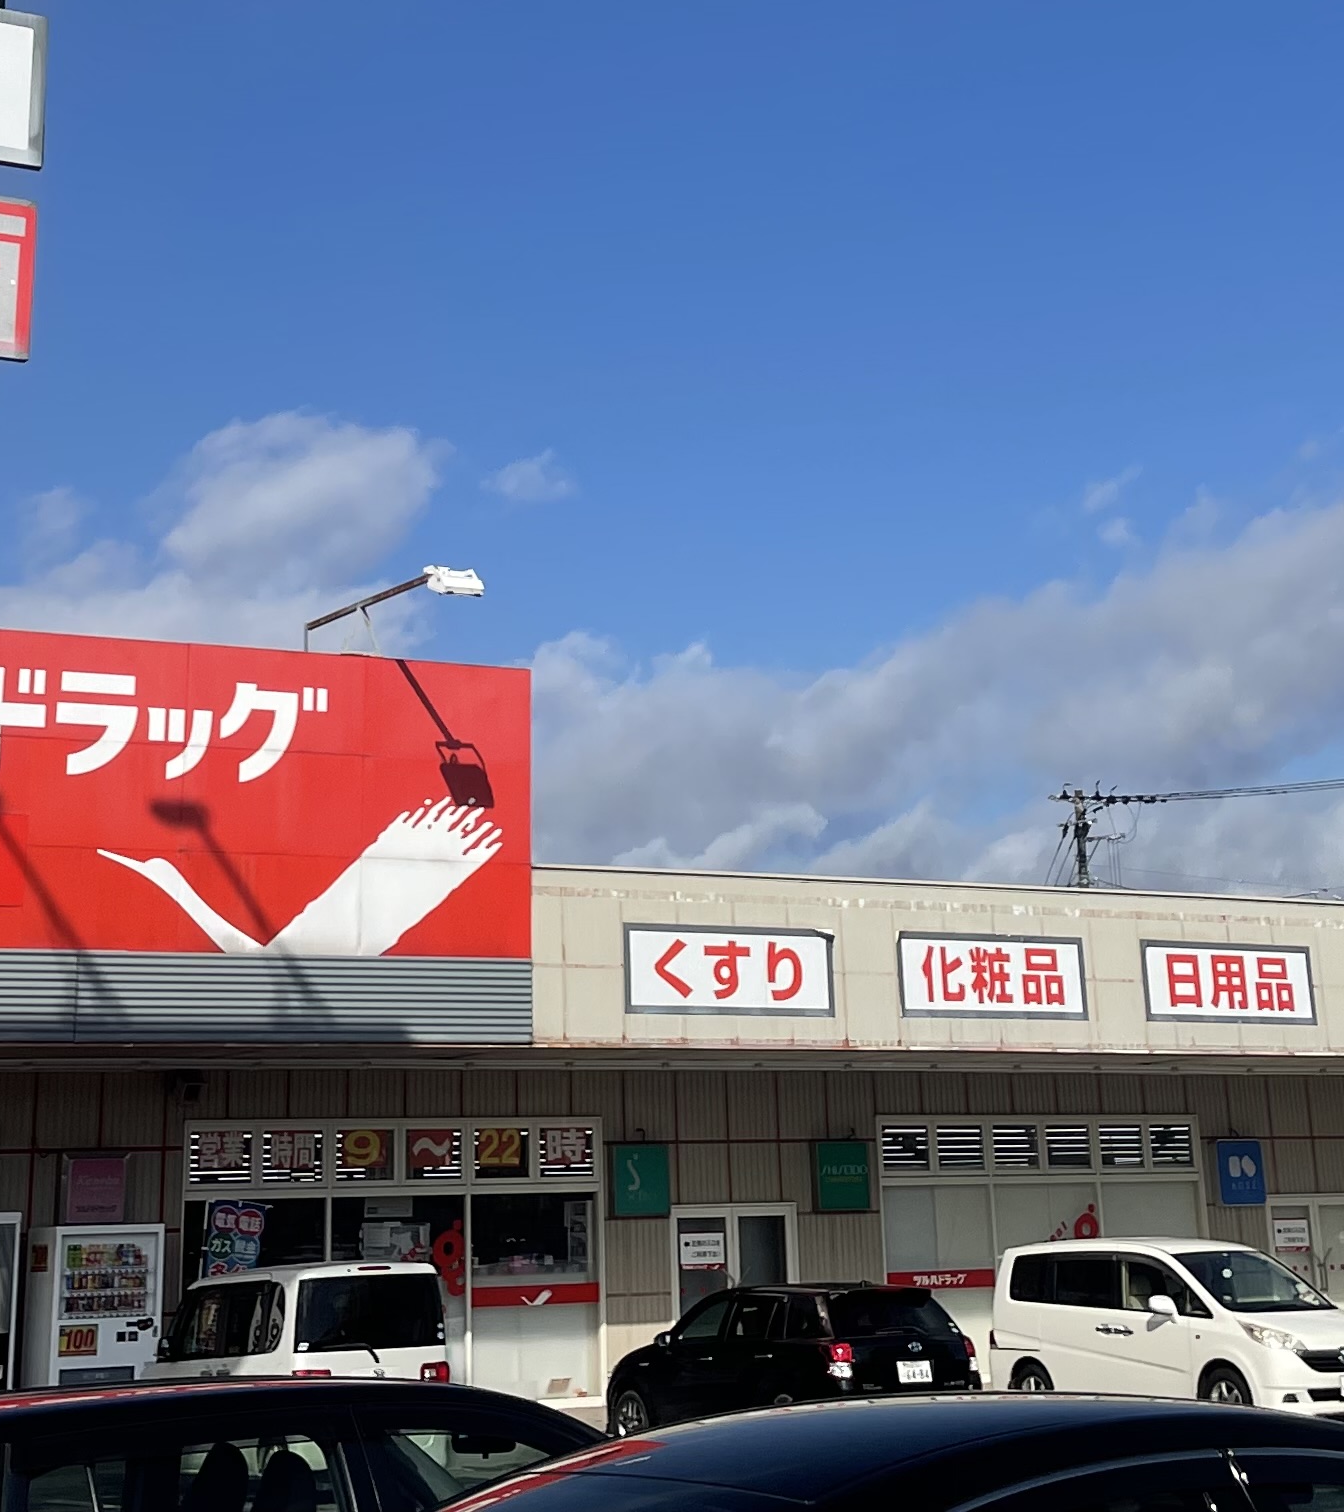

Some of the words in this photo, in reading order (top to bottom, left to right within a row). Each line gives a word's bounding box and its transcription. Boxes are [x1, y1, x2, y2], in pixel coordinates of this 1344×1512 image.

[654, 938, 803, 1002] くすり
[921, 945, 1066, 1007] 化粧品
[1165, 953, 1296, 1013] 日用品
[211, 1237, 232, 1253] ガス
[65, 1327, 95, 1350] 100
